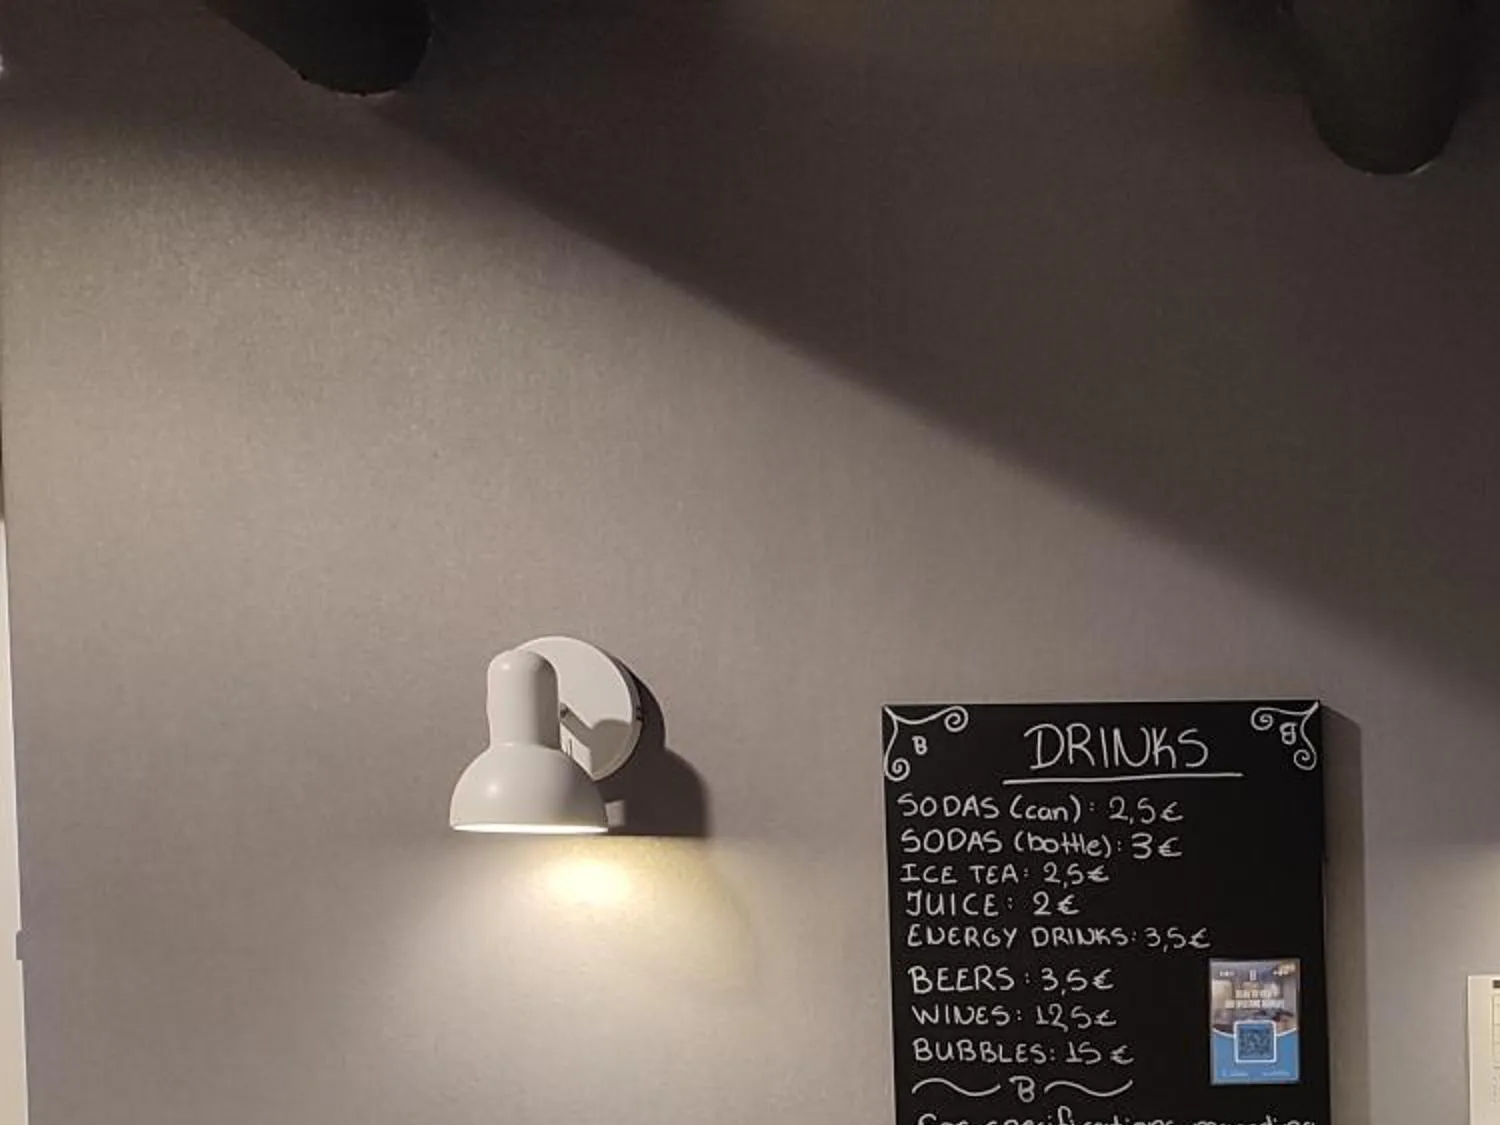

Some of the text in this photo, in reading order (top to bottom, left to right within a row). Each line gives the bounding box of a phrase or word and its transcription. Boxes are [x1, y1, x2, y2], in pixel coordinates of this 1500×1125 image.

[1024, 723, 1208, 769] DRINKS
[898, 793, 999, 818] SODAS
[902, 828, 1002, 853] SODAS
[900, 864, 957, 884] ICE
[970, 864, 1028, 884] TEA:
[906, 890, 1012, 916] JUICE:
[908, 924, 1017, 948] ENERGY
[1032, 927, 1137, 947] DRINKS:
[908, 965, 1029, 994] BEERS:
[912, 1005, 1021, 1026] WINES:
[913, 1038, 1054, 1064] BUBBLES:
